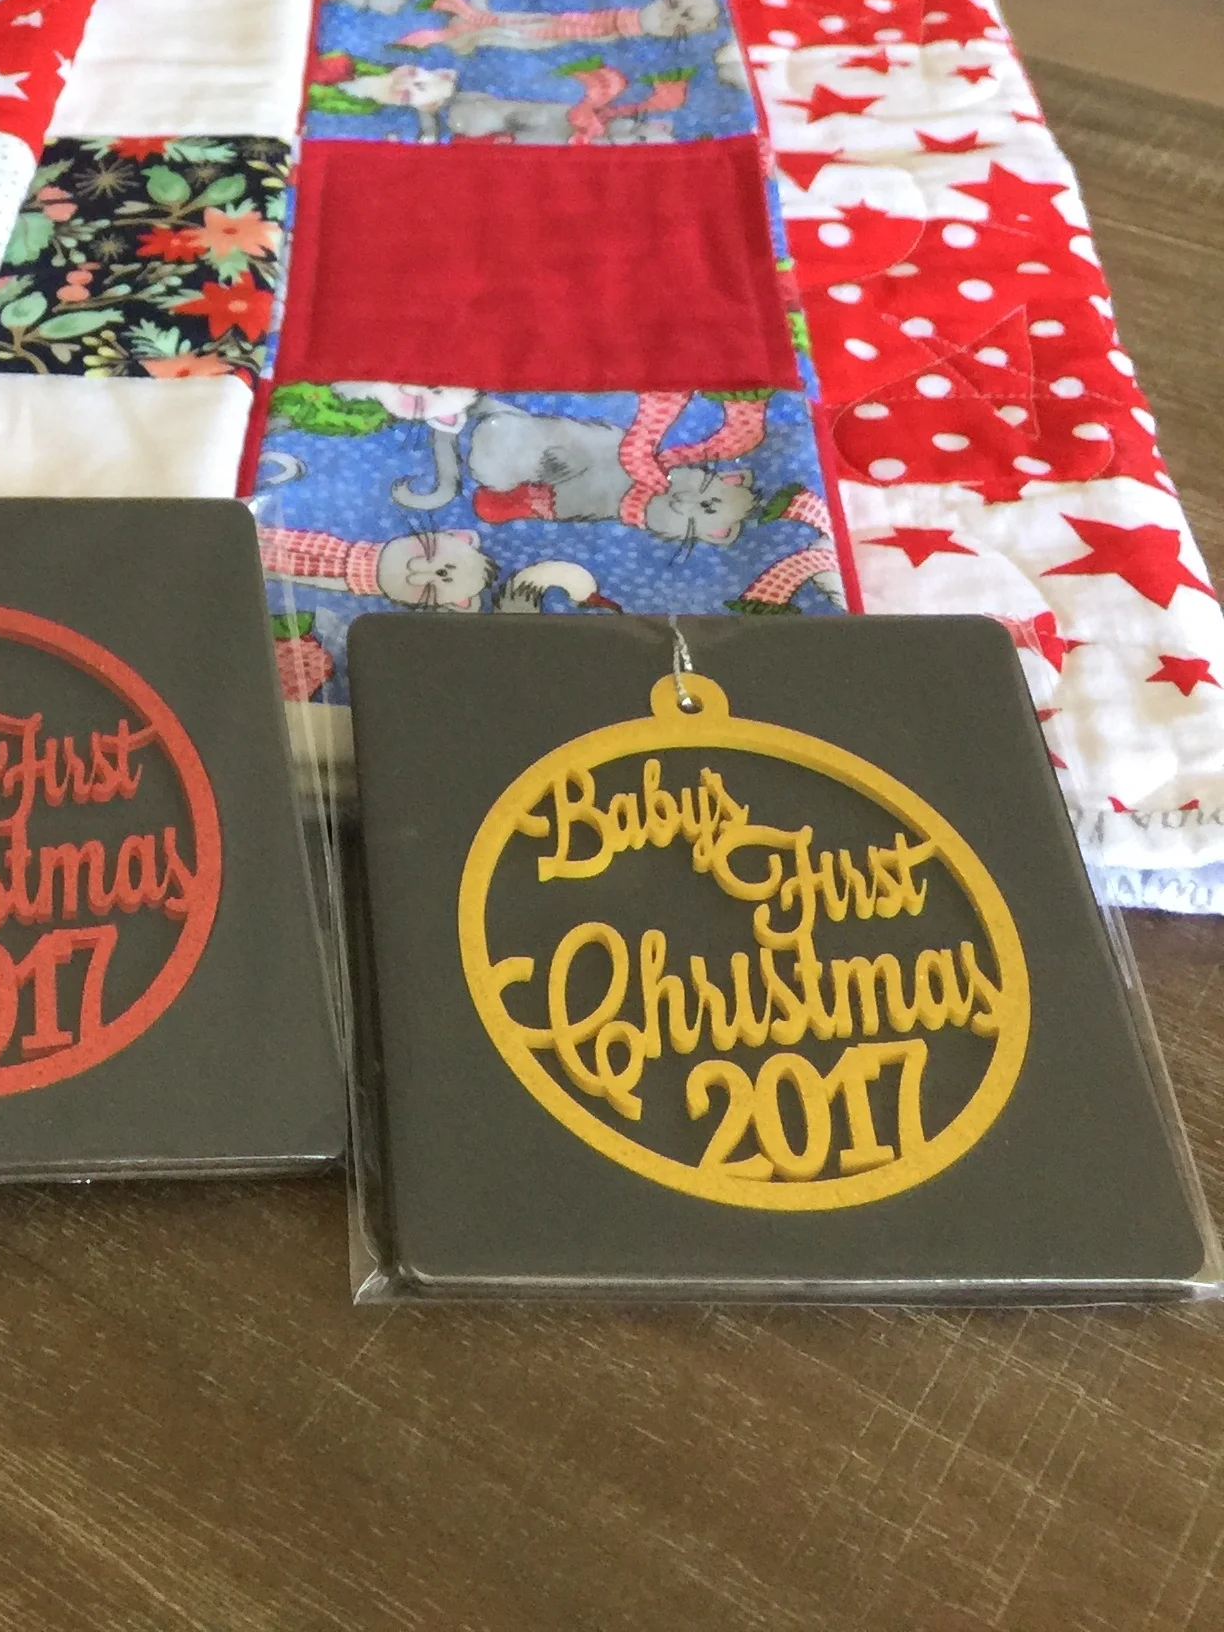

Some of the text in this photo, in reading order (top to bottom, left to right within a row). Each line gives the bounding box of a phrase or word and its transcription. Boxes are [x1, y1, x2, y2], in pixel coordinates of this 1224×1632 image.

[712, 825, 935, 952] First
[489, 922, 1000, 1121] Christmas
[686, 1039, 928, 1182] 2017
